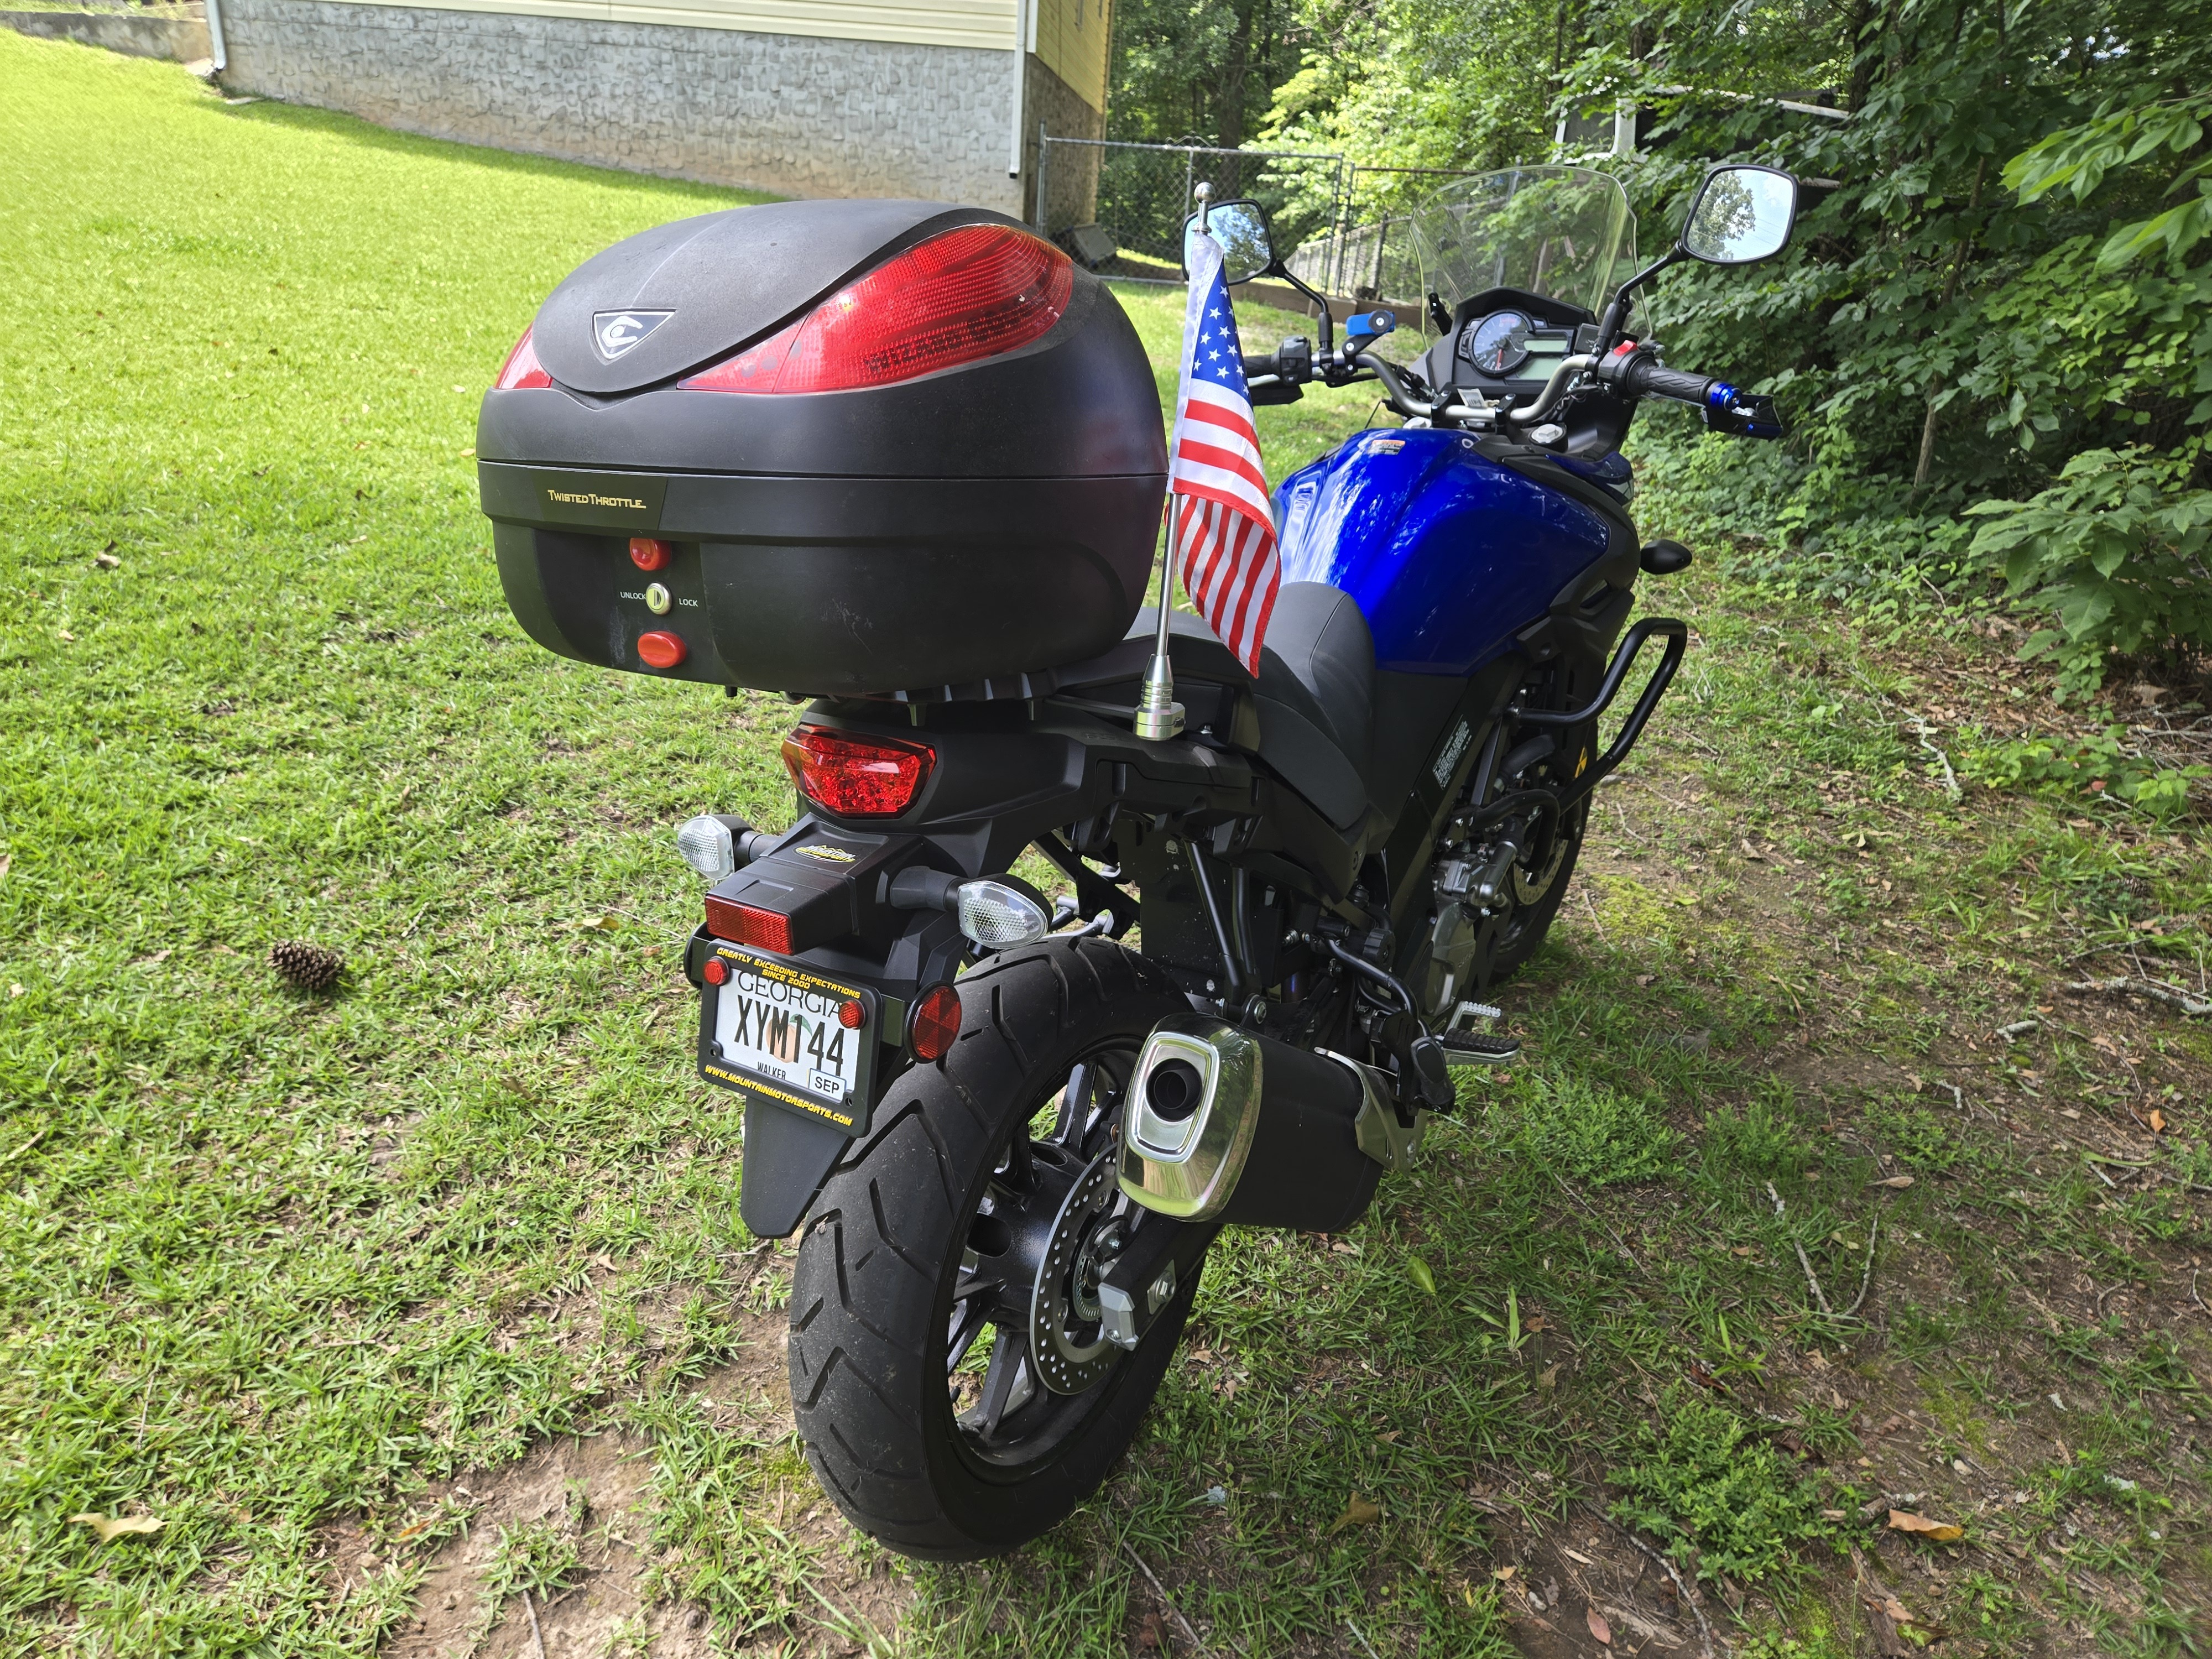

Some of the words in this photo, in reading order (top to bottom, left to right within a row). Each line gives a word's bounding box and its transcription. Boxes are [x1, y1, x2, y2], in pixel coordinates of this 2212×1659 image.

[620, 591, 646, 600] UNLOCK
[679, 598, 698, 607] LOCK
[716, 947, 753, 963] GREATLY
[754, 958, 798, 978] EXCEEDING
[800, 973, 861, 999] EXPECTATIONS
[761, 969, 786, 982] SINCE
[787, 977, 811, 989] 2000
[734, 994, 844, 1076] XYM144
[757, 1061, 786, 1080] WALKER
[815, 1076, 840, 1094] SEP
[705, 1065, 853, 1126] WWW.MOUNTAINMOTORSPORTS.COM
